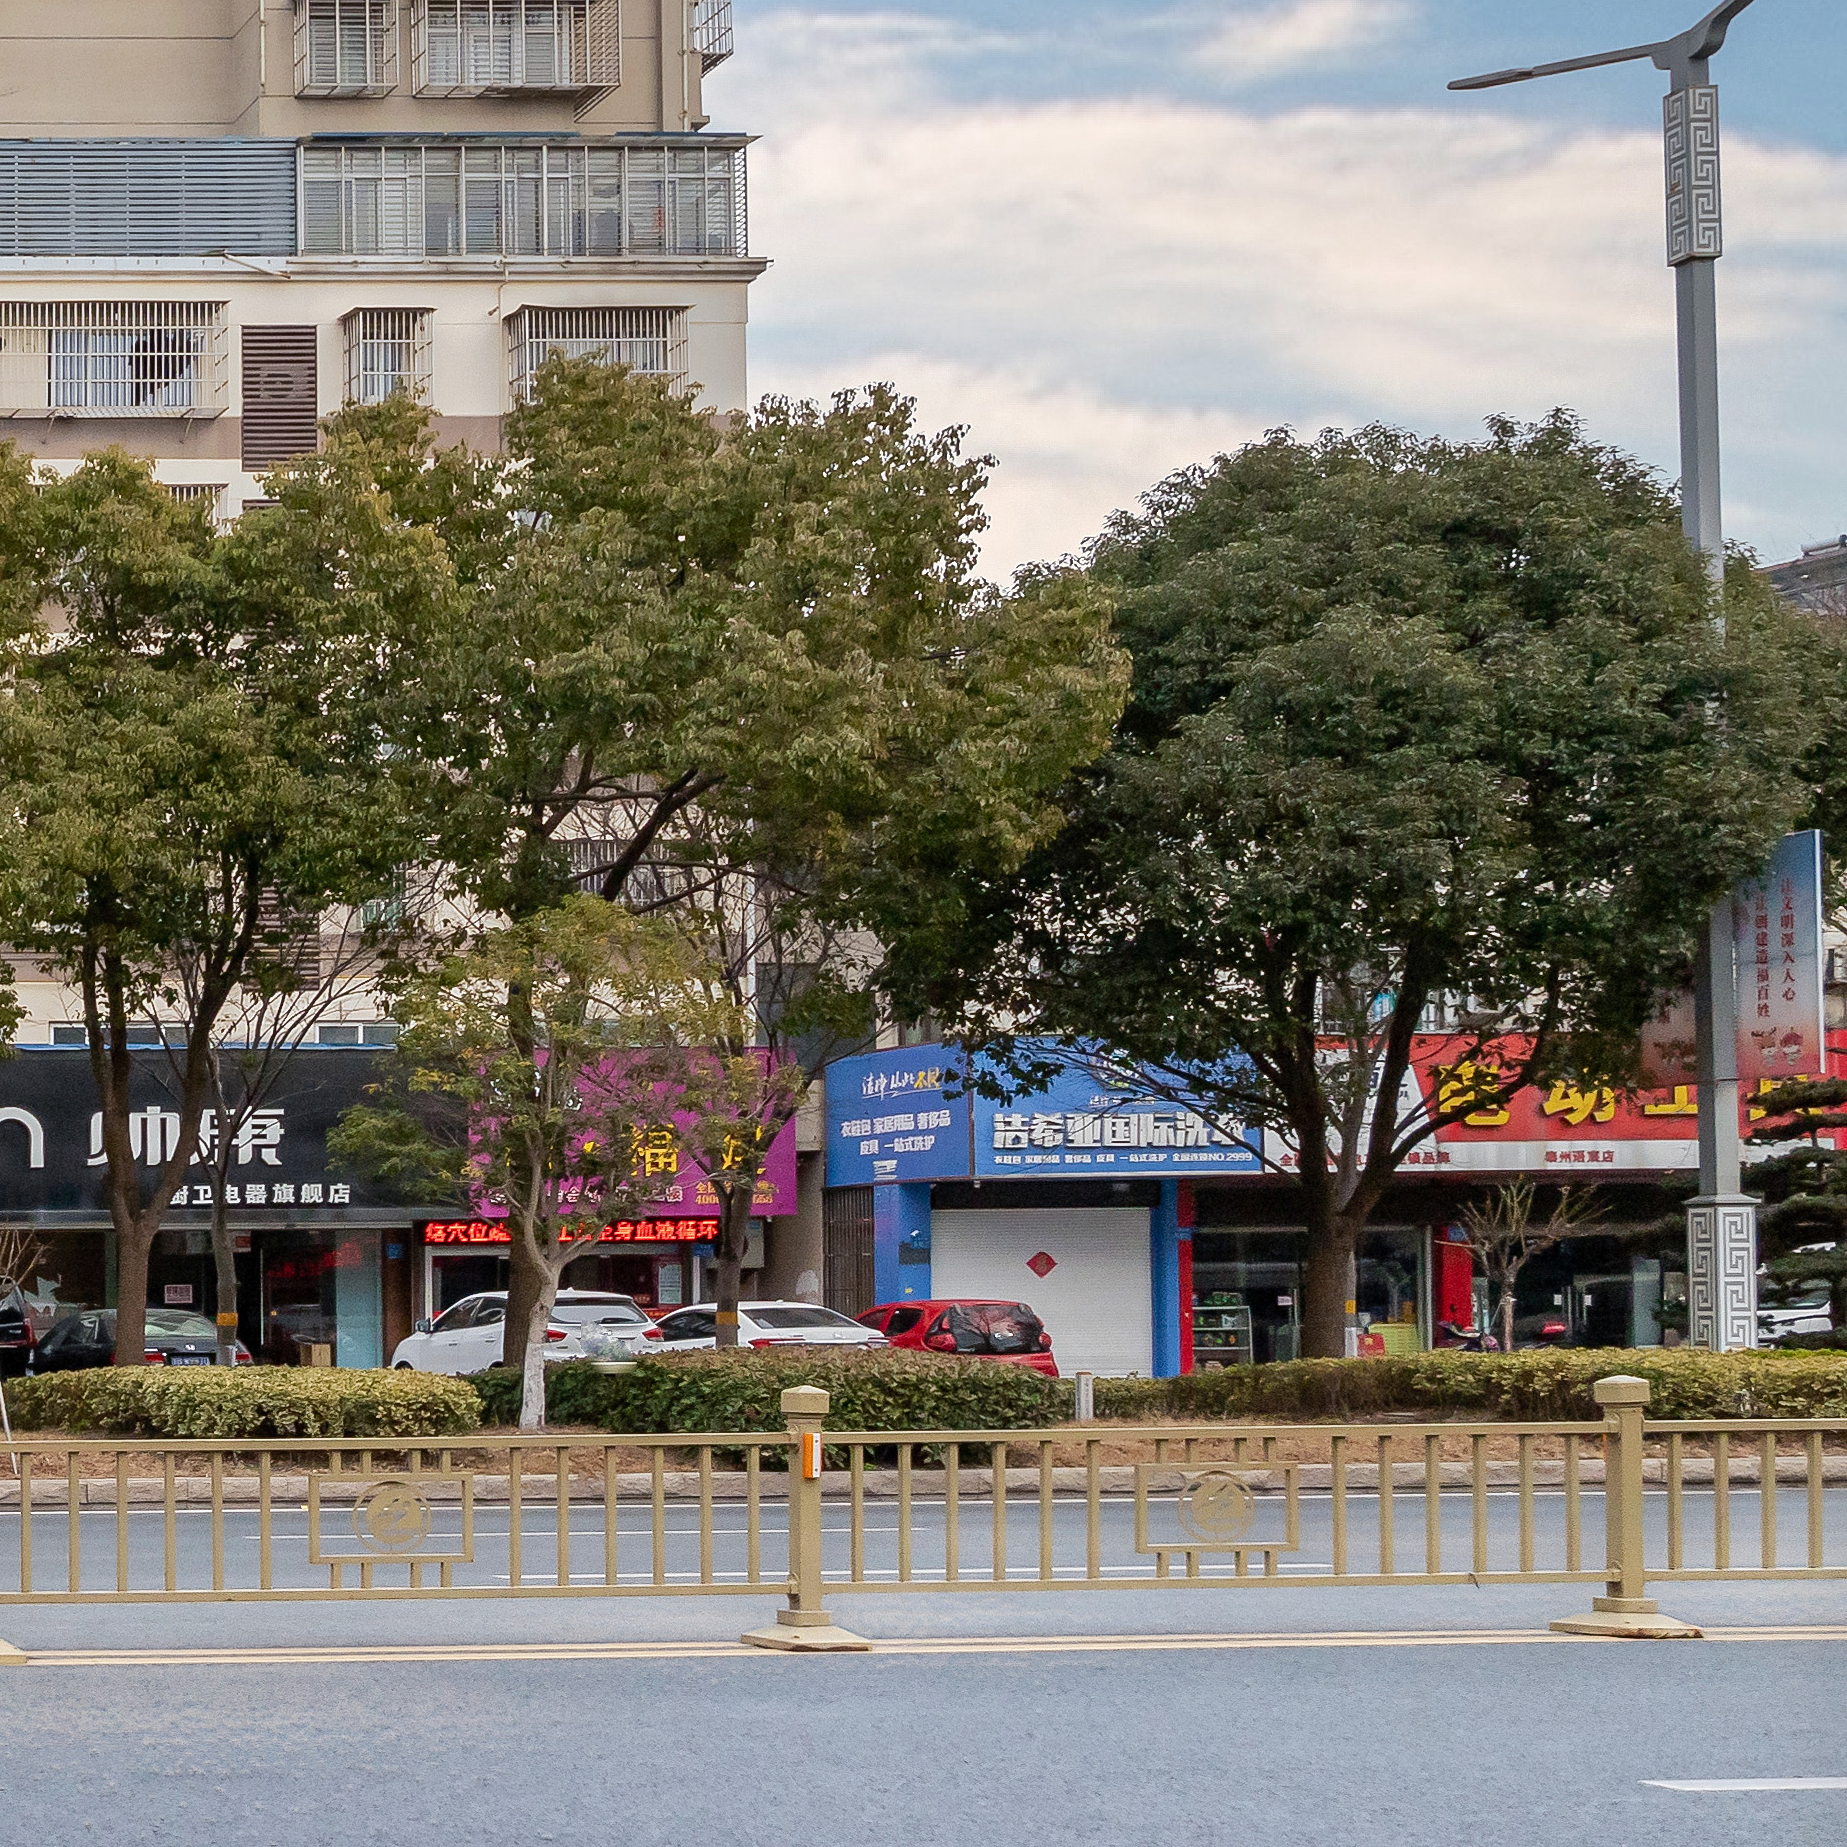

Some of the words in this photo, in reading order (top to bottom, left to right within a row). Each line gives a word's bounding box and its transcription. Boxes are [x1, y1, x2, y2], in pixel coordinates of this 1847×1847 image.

[170, 1183, 351, 1205] 厨卫电器旗舰店
